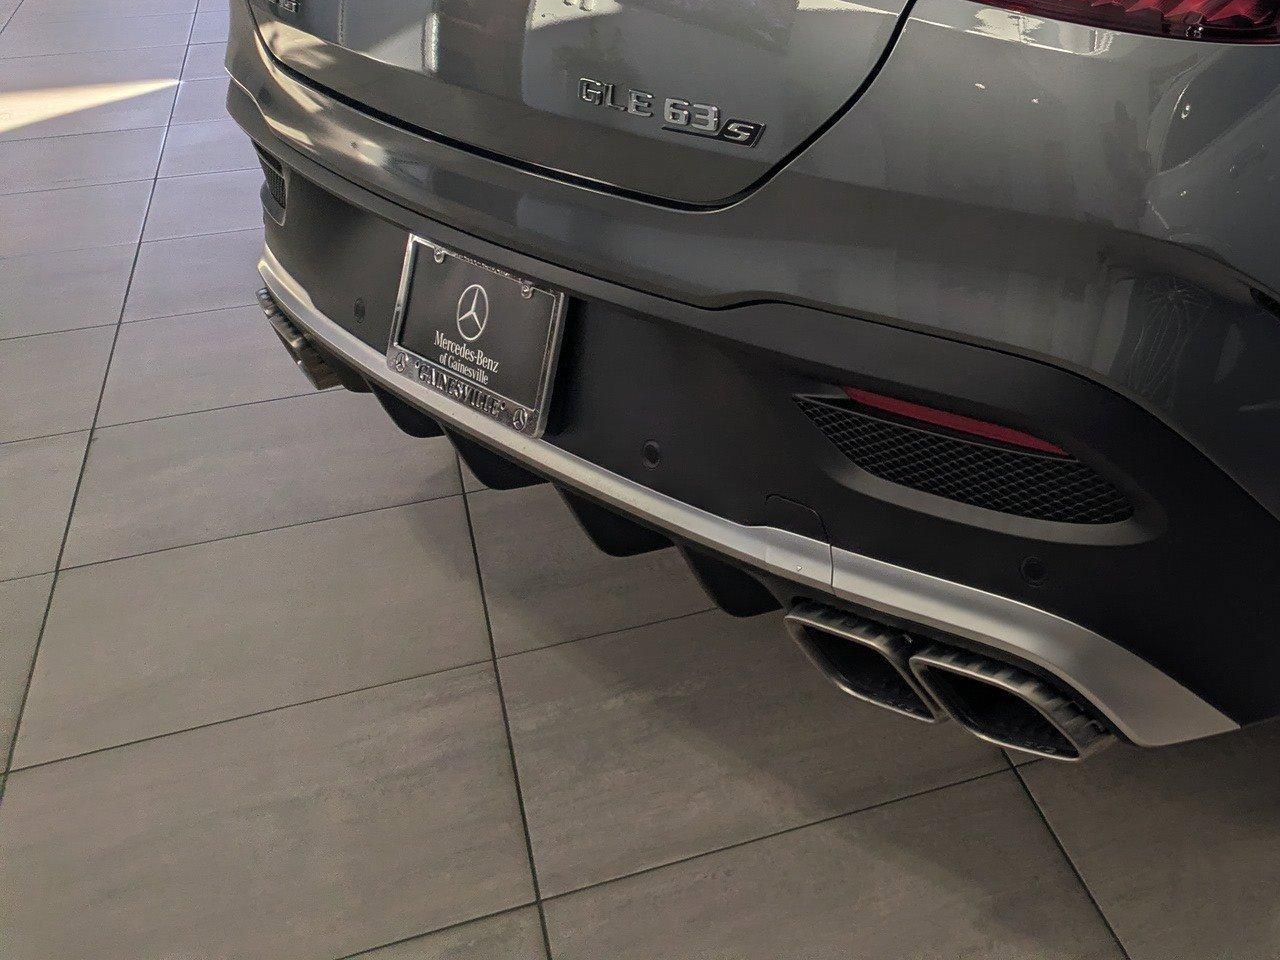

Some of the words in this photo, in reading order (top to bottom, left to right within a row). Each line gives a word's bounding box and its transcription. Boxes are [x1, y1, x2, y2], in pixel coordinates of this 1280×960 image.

[578, 77, 654, 117] GLE
[664, 97, 720, 132] 63
[724, 122, 755, 141] S
[434, 330, 499, 373] Mercedes-Benz
[439, 353, 448, 365] of
[448, 356, 489, 385] Gainesville
